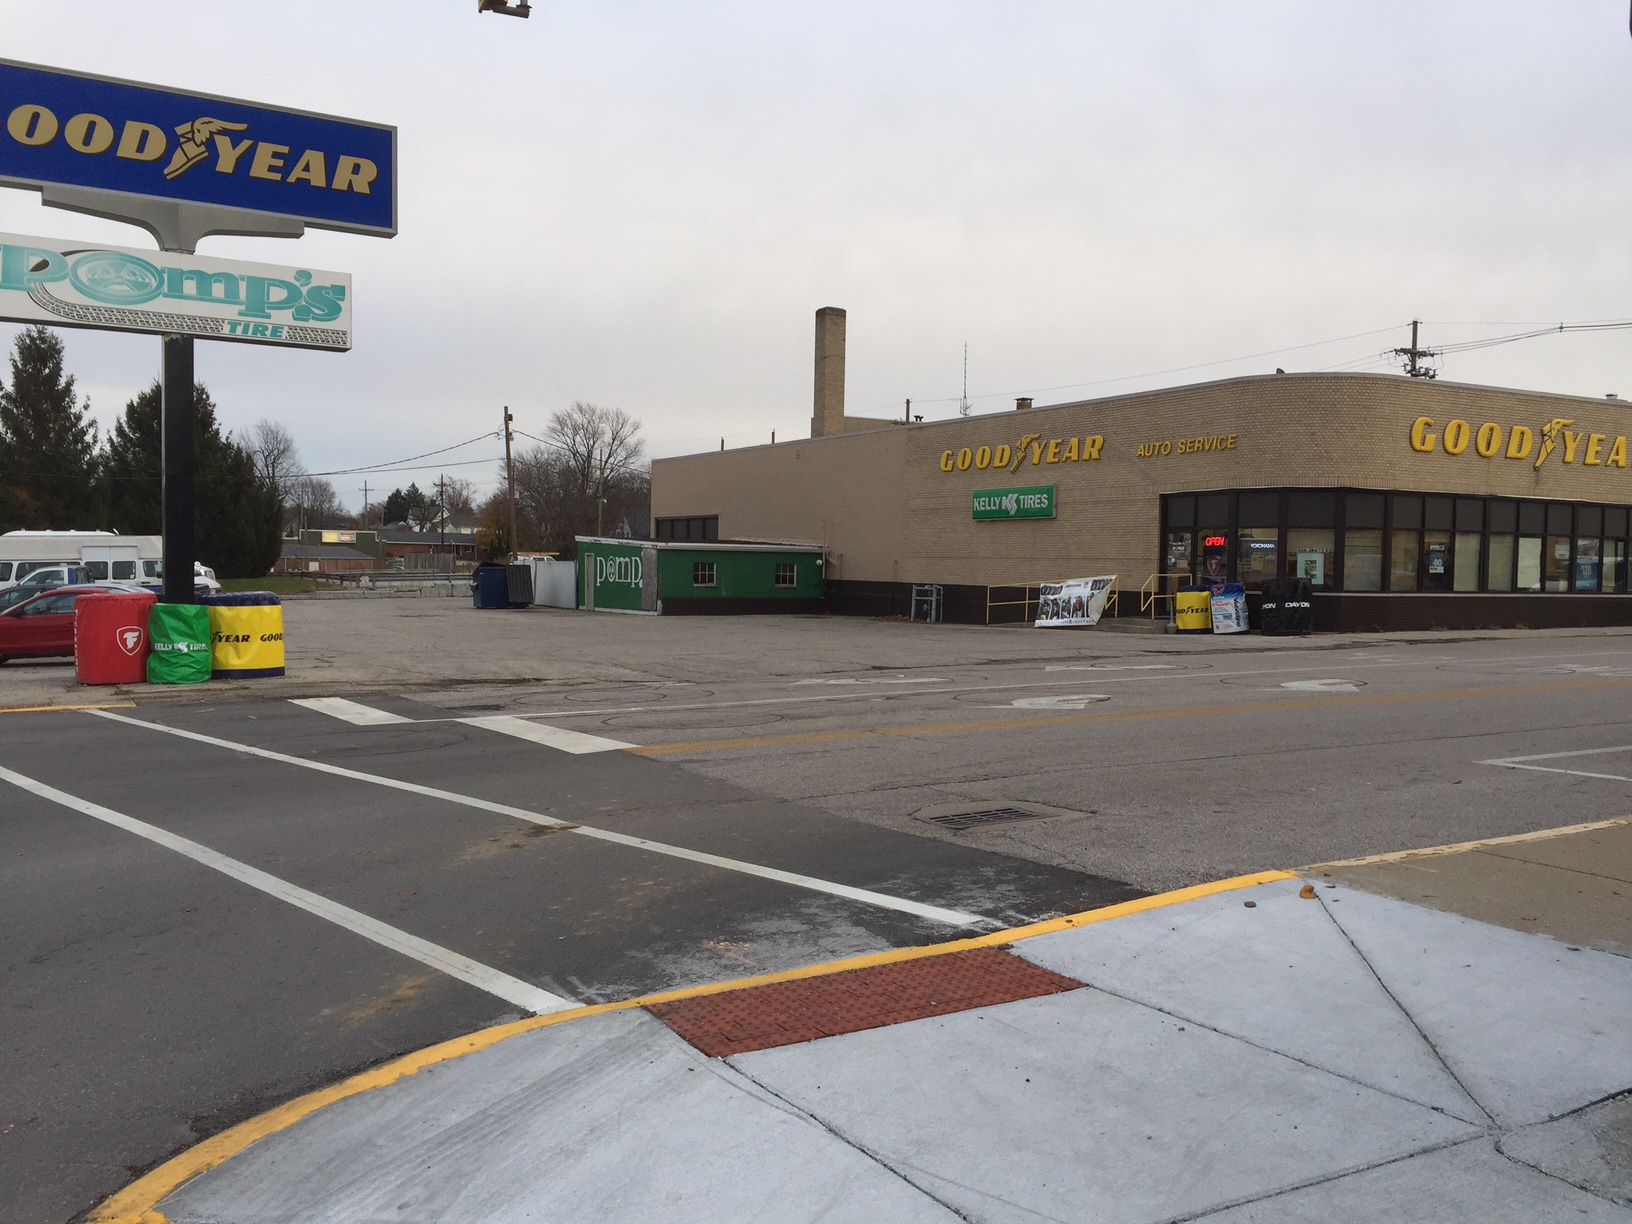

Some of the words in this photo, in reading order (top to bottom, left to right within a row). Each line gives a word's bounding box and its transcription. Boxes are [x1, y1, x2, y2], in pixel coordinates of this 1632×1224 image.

[0, 104, 378, 195] OODYEAR
[227, 320, 285, 339] TIRE
[940, 434, 1104, 473] GOODYEAR
[1136, 441, 1171, 457] AUTO
[1177, 434, 1237, 453] SERVICE
[1410, 416, 1632, 468] GOODYEA
[973, 496, 1002, 511] KELLY
[1019, 493, 1049, 509] TIRES
[1205, 536, 1225, 546] OPEN
